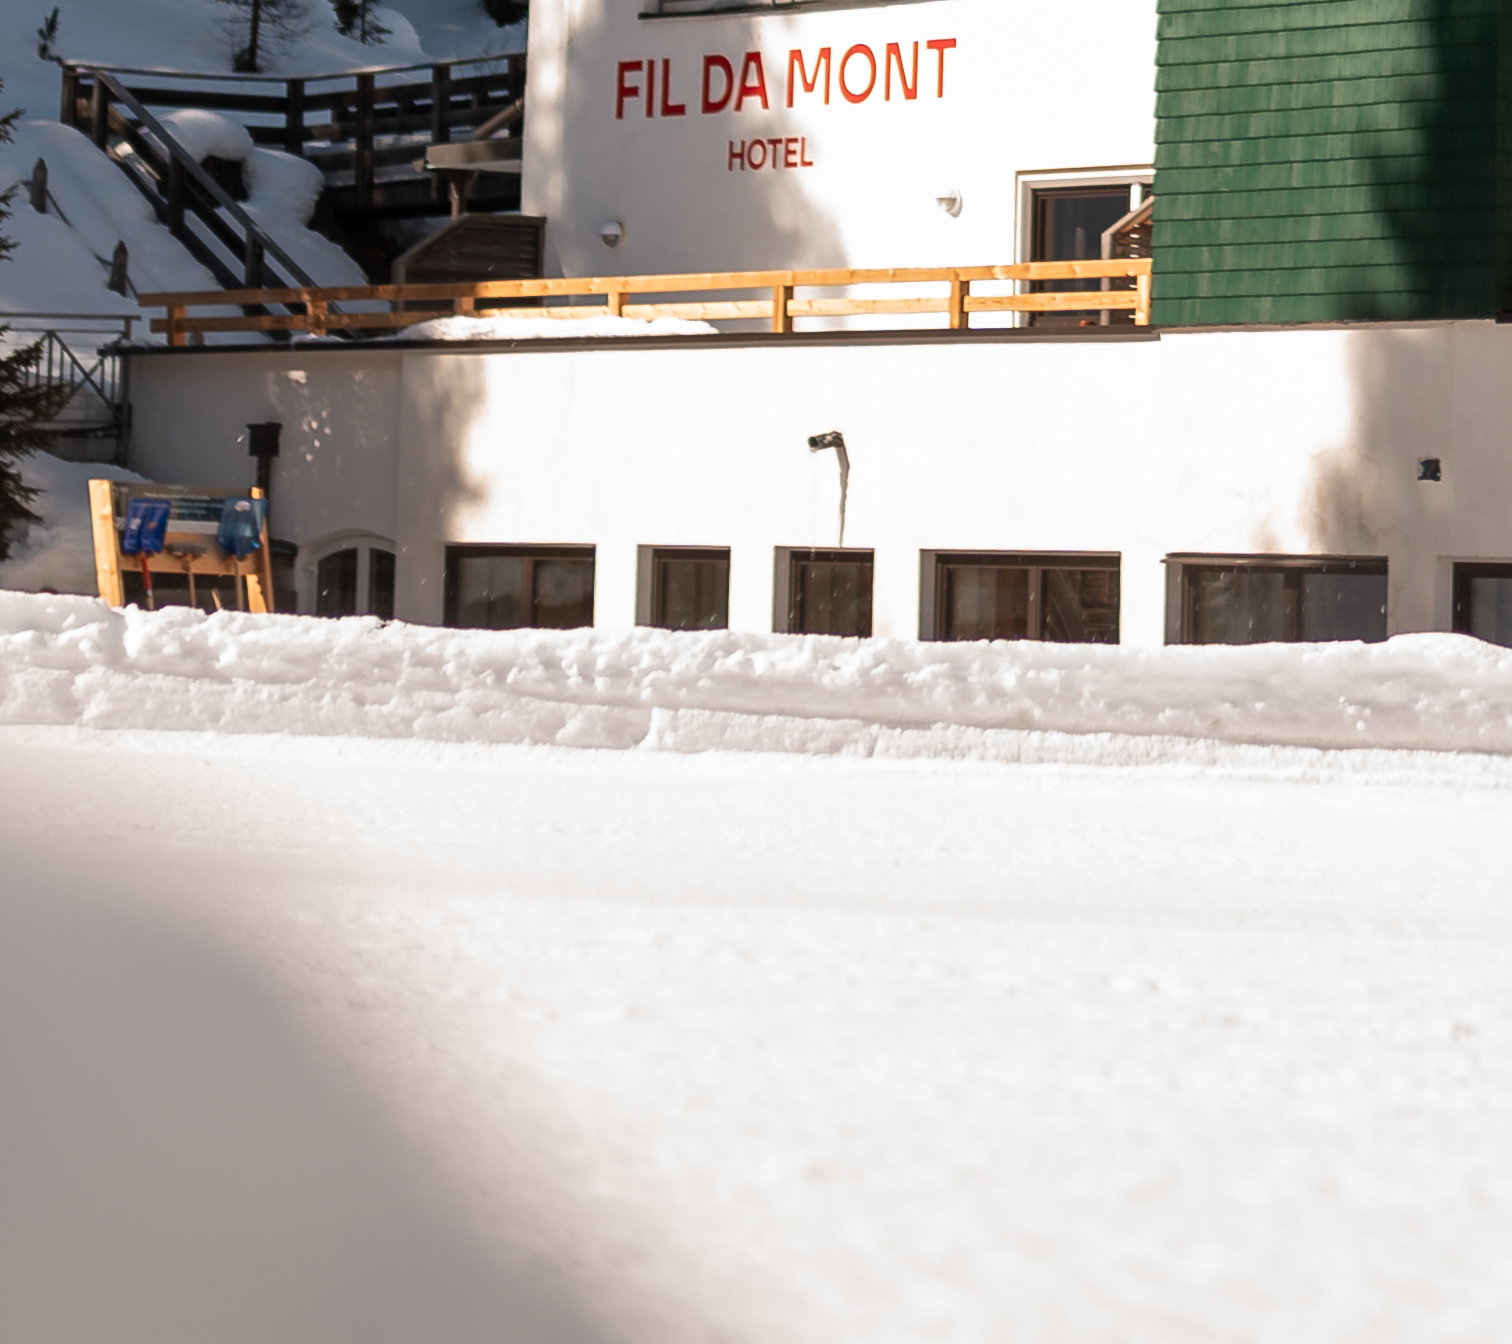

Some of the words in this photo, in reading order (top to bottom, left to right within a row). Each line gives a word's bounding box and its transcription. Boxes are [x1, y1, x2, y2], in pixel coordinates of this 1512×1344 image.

[615, 59, 687, 120] FIL
[701, 51, 769, 115] DA
[787, 38, 957, 108] MONT
[728, 136, 814, 172] HOTEL
